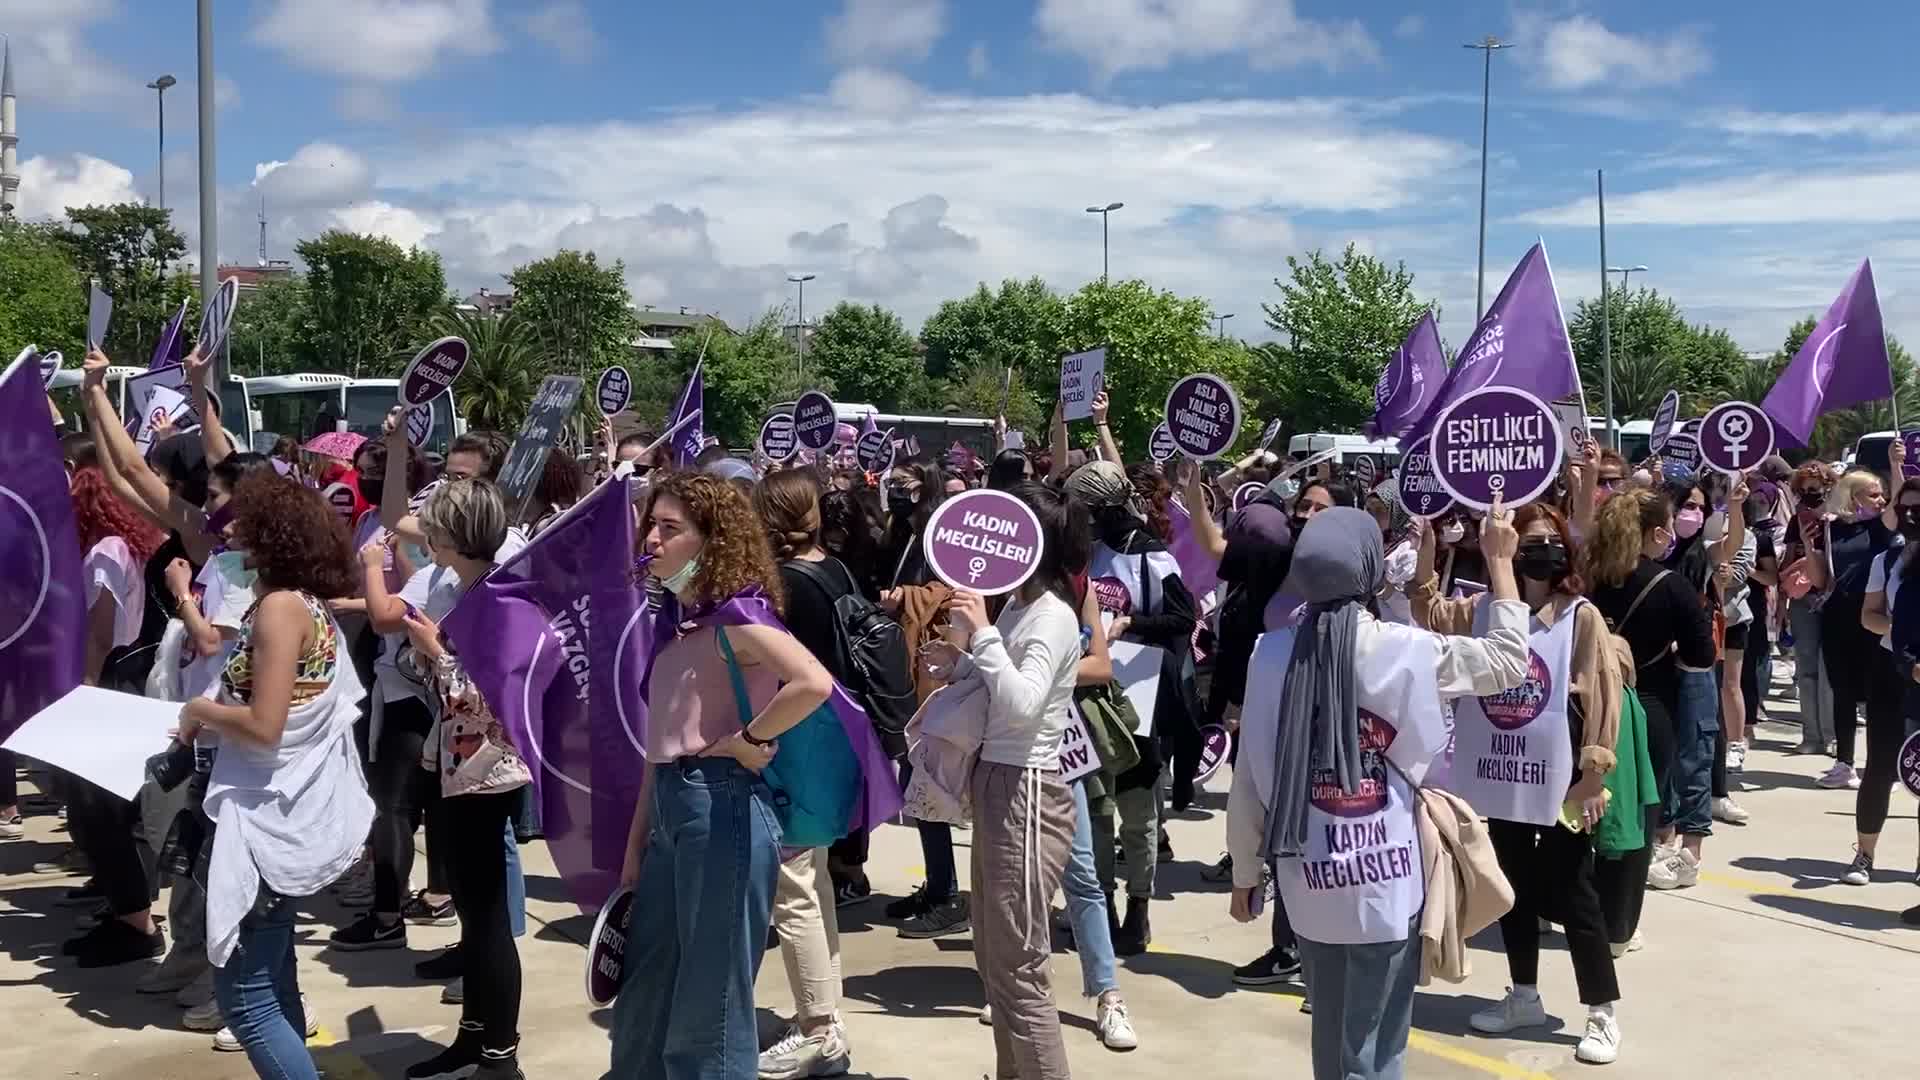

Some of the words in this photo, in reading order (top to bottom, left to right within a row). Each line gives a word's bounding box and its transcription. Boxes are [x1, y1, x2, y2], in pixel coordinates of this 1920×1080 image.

[1063, 358, 1083, 375] BOLU
[1195, 382, 1217, 401] ASLA
[801, 403, 824, 418] KADIN
[1188, 397, 1218, 418] YALNIZ
[1179, 428, 1210, 450] CEKSİN
[1447, 411, 1543, 448] EŞİTLİKÇİ
[1407, 450, 1433, 474] EŞİT
[1447, 443, 1545, 473] FEMİNİZM
[962, 510, 1019, 538] KADIN
[935, 527, 1033, 565] MECLİSLERİ
[1491, 734, 1527, 757] KADIN
[1477, 756, 1546, 785] MECLİSLERİ
[1325, 819, 1388, 854] KADIN
[1303, 840, 1413, 890] MECLİSLERİ
